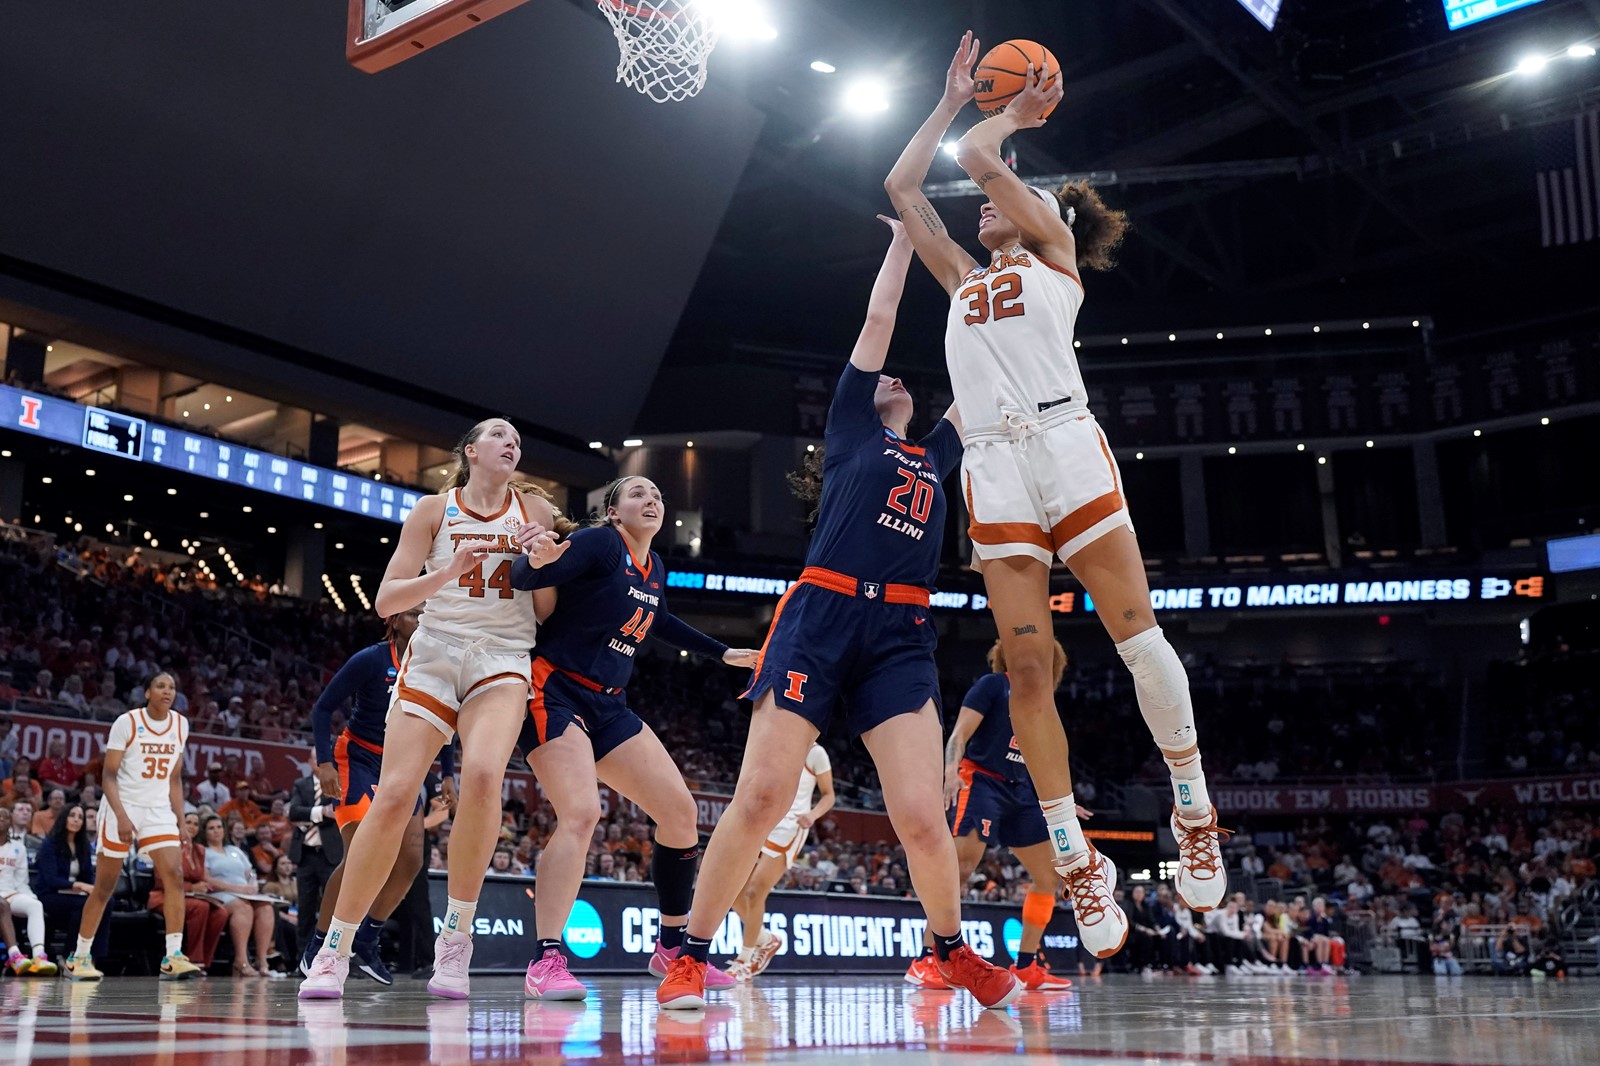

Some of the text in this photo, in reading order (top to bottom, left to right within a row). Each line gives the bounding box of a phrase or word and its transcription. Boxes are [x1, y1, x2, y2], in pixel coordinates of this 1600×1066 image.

[960, 272, 1025, 327] 32
[153, 446, 162, 462] 2
[883, 448, 938, 484] FIGHING
[887, 466, 934, 524] 20
[876, 512, 924, 541] ILLINI
[459, 559, 514, 599] 44
[666, 571, 705, 589] 2025
[725, 575, 787, 595] WOMEN'S
[628, 586, 660, 607] FIGHTING
[1208, 587, 1241, 607] TO
[1246, 583, 1339, 606] MARCH
[1344, 579, 1471, 603] MADNESS
[620, 606, 655, 643] 44
[608, 637, 636, 657] ILLINI
[784, 670, 808, 703] I
[140, 742, 176, 755] TEXAS
[141, 757, 170, 780] 35
[1216, 789, 1282, 811] HOOK
[1345, 788, 1431, 810] HORNS
[432, 916, 524, 936] NSAN
